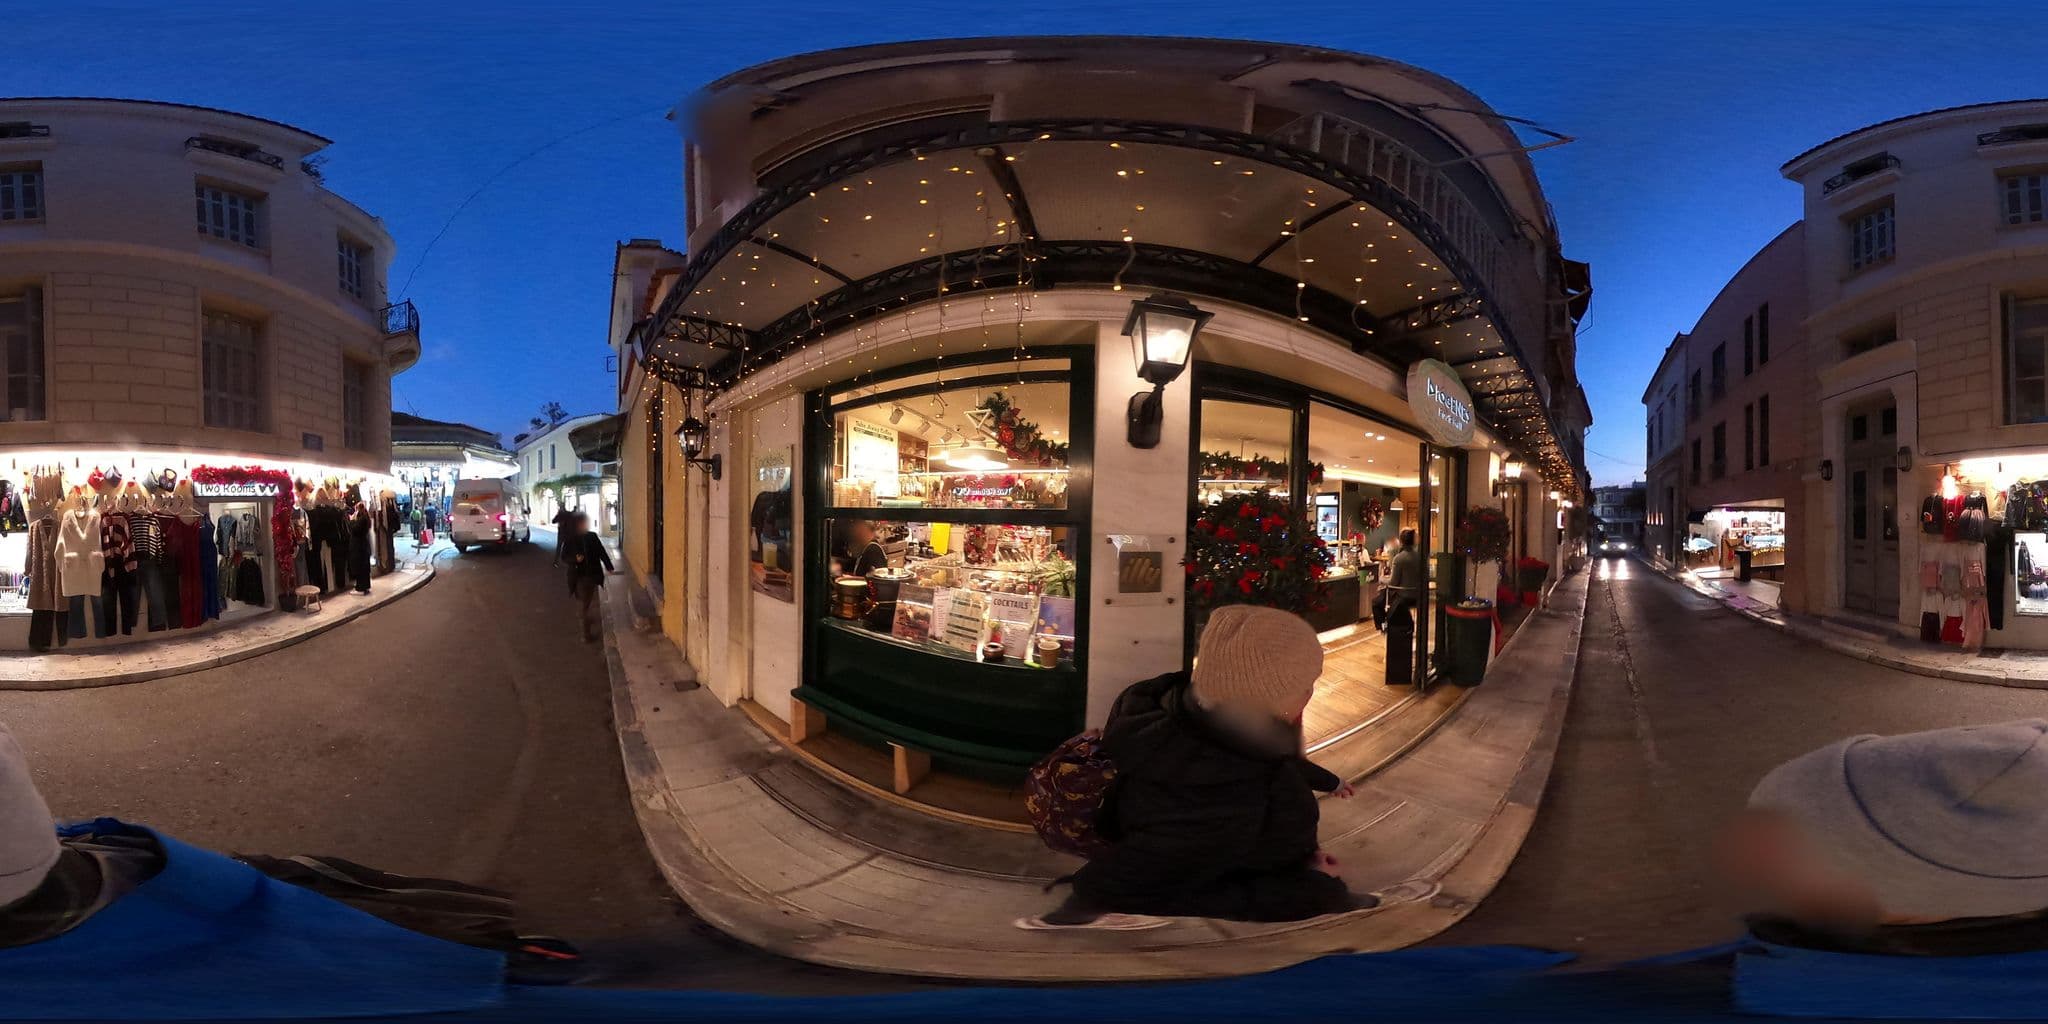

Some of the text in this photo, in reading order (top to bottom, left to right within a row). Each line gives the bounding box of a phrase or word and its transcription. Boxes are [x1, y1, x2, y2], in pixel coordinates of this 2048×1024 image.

[200, 483, 257, 494] Two Rooms
[993, 598, 1029, 610] COCKTAILS
